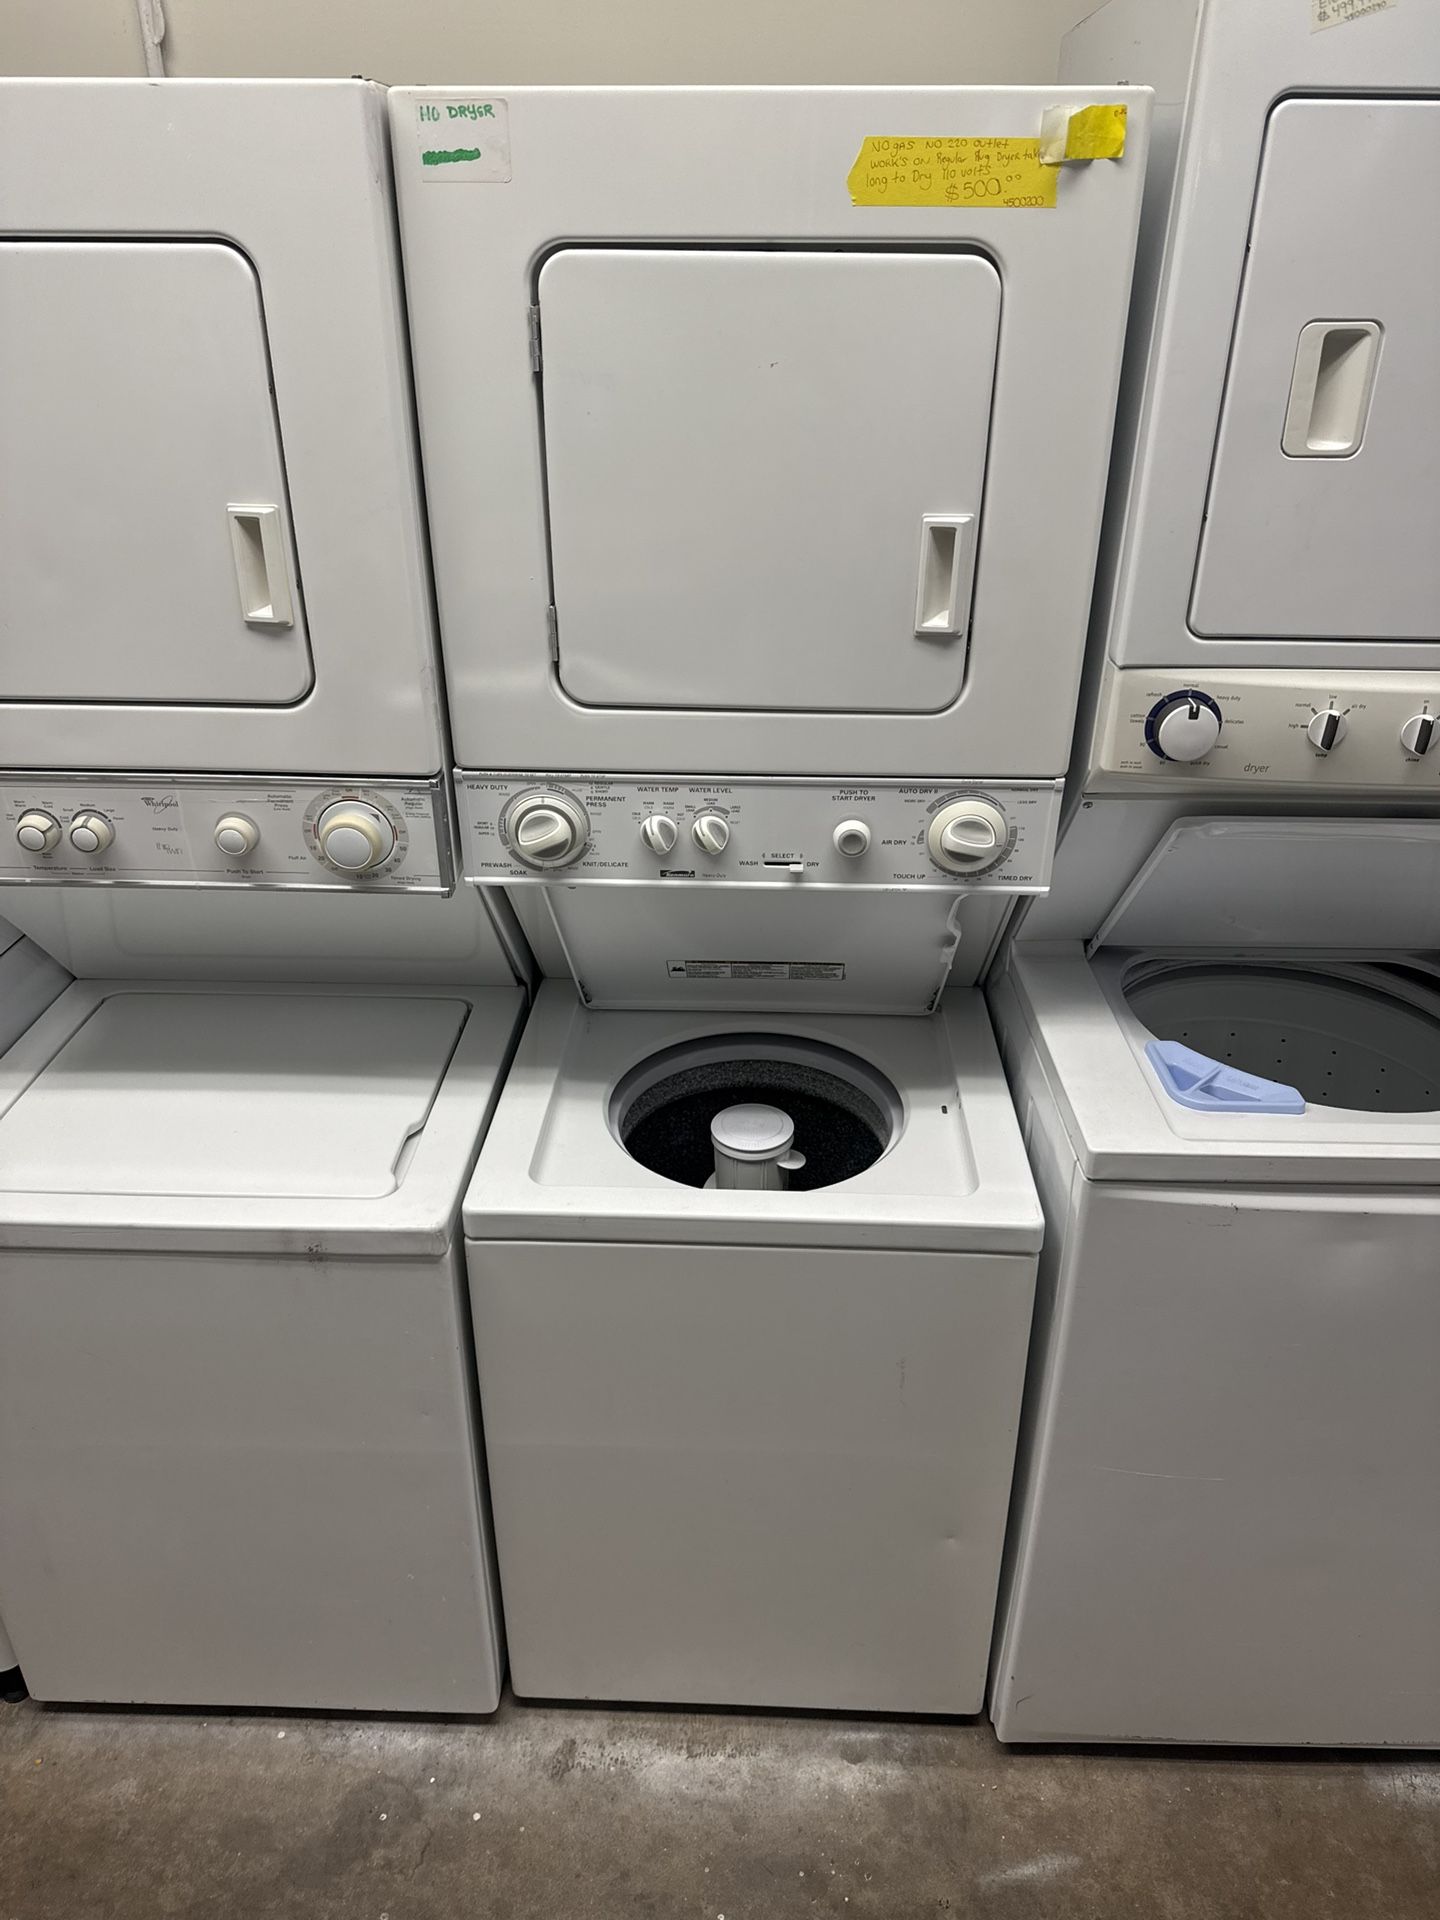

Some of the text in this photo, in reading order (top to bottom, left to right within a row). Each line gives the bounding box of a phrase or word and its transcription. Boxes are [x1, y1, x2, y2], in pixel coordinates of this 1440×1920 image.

[925, 139, 943, 149] NO
[948, 139, 968, 149] 220
[936, 151, 968, 169] Regular
[865, 173, 888, 194] long
[892, 171, 906, 184] to
[912, 169, 932, 191] Dry
[1243, 762, 1270, 775] dryer
[688, 787, 713, 795] WATER
[141, 796, 179, 812] Whirlpool
[585, 795, 626, 803] PERMANENT
[582, 861, 629, 869] KNIT/DELICATE
